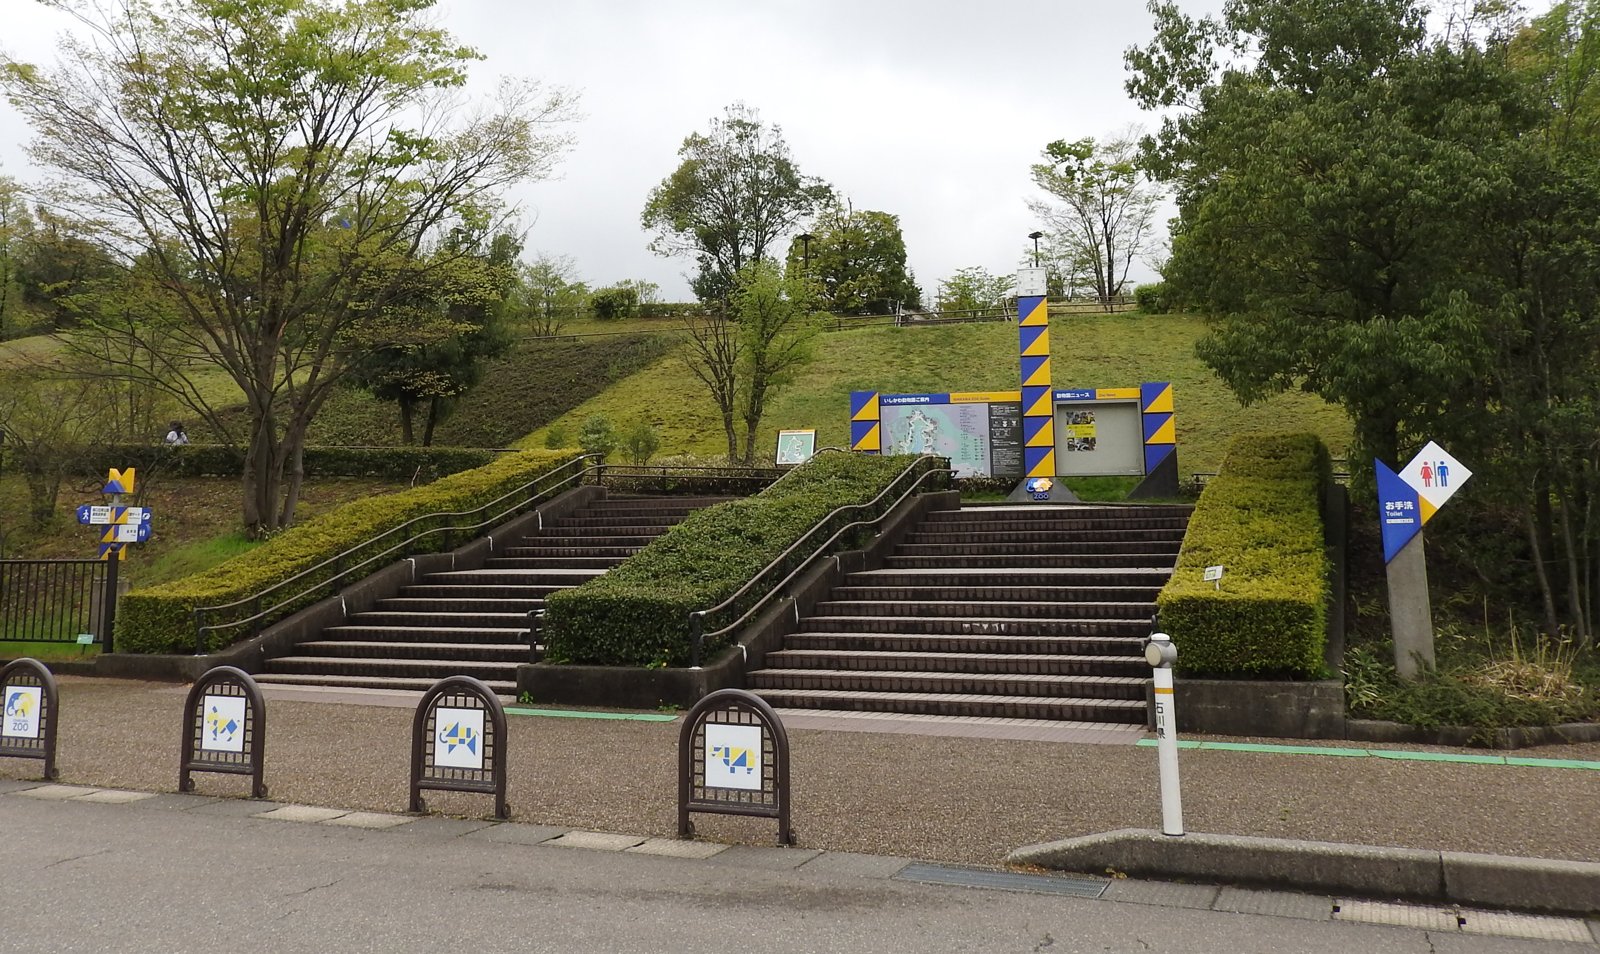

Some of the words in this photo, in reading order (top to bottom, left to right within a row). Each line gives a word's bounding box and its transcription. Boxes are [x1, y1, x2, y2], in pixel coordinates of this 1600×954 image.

[1385, 501, 1414, 510] お手洗
[12, 722, 29, 732] ZOO
